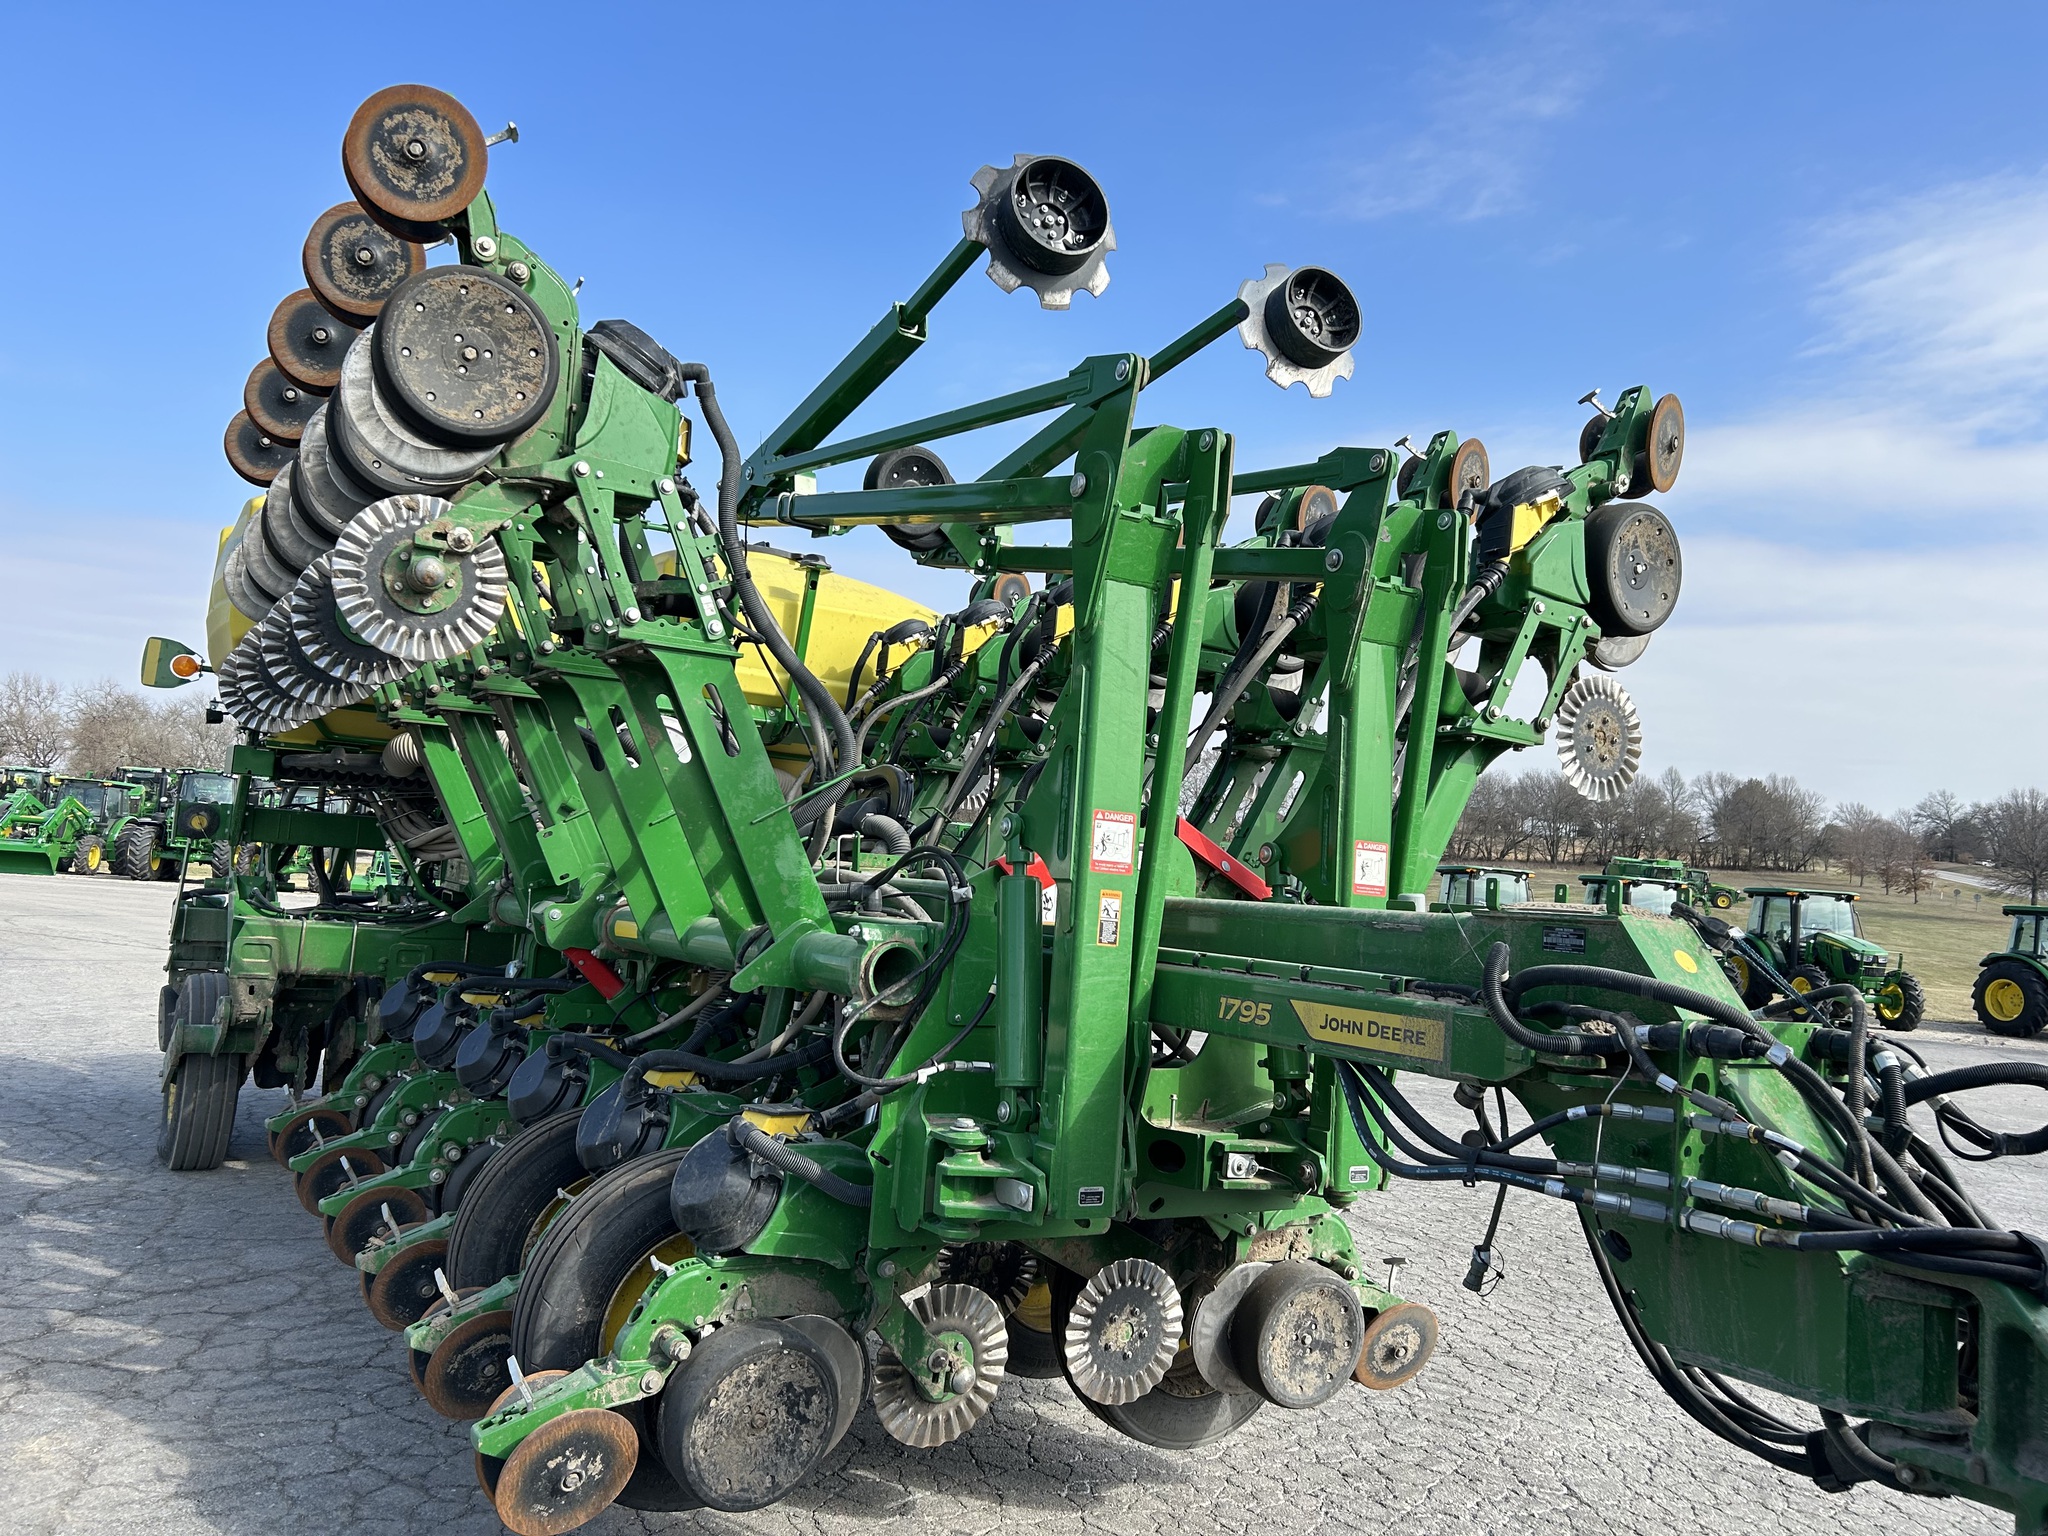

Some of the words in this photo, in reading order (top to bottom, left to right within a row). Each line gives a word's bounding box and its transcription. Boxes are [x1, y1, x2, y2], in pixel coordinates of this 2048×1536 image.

[1104, 812, 1134, 823] DANGER
[1218, 997, 1273, 1026] 1795
[1319, 1013, 1363, 1036] JOHN
[1367, 1020, 1426, 1046] DEERE
